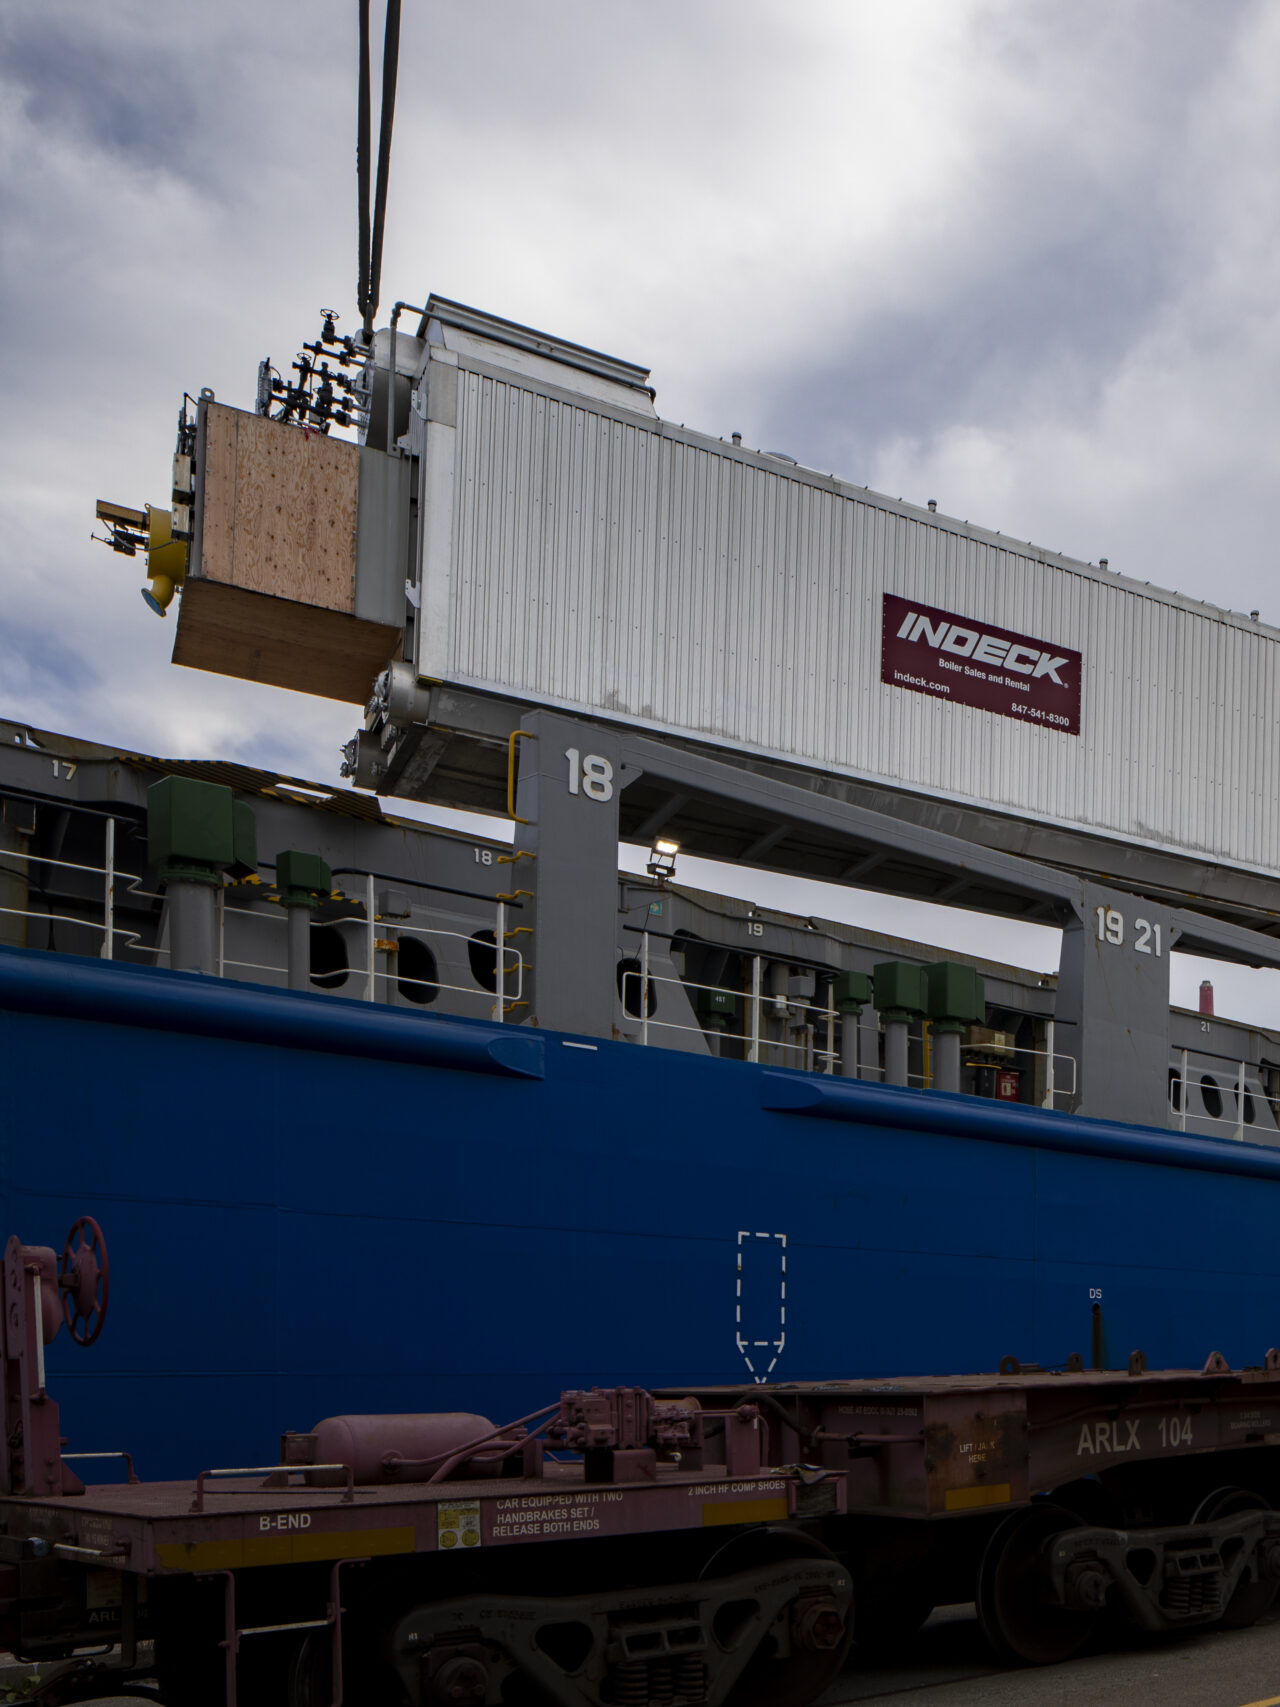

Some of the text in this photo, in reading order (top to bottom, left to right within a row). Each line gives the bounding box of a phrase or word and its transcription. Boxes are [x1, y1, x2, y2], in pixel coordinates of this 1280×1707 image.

[897, 611, 1070, 686] INDECK
[894, 669, 951, 694] indeck.com
[939, 658, 1031, 692] Boiler Sales and Rental
[1011, 702, 1070, 727] 847-541-8300
[52, 759, 77, 782] 17
[565, 747, 613, 802] 18
[473, 848, 493, 866] 18
[747, 922, 764, 937] 19
[1096, 907, 1162, 956] 19 21
[1201, 1021, 1211, 1033] 21
[1089, 1288, 1103, 1299] DS
[1077, 1416, 1194, 1457] ARLX 104
[960, 1442, 973, 1453] LIFT
[968, 1453, 986, 1464] HERE
[688, 1479, 786, 1496] 2 INCH HF COMP SHOES
[497, 1490, 624, 1510] CAR EQUIPPED WITH TWO
[258, 1512, 312, 1532] B-END
[497, 1508, 568, 1524] HANDBRAKES
[570, 1506, 589, 1519] SET
[492, 1518, 600, 1537] RELEASE BOTH ENDS
[88, 1609, 121, 1625] ARL
